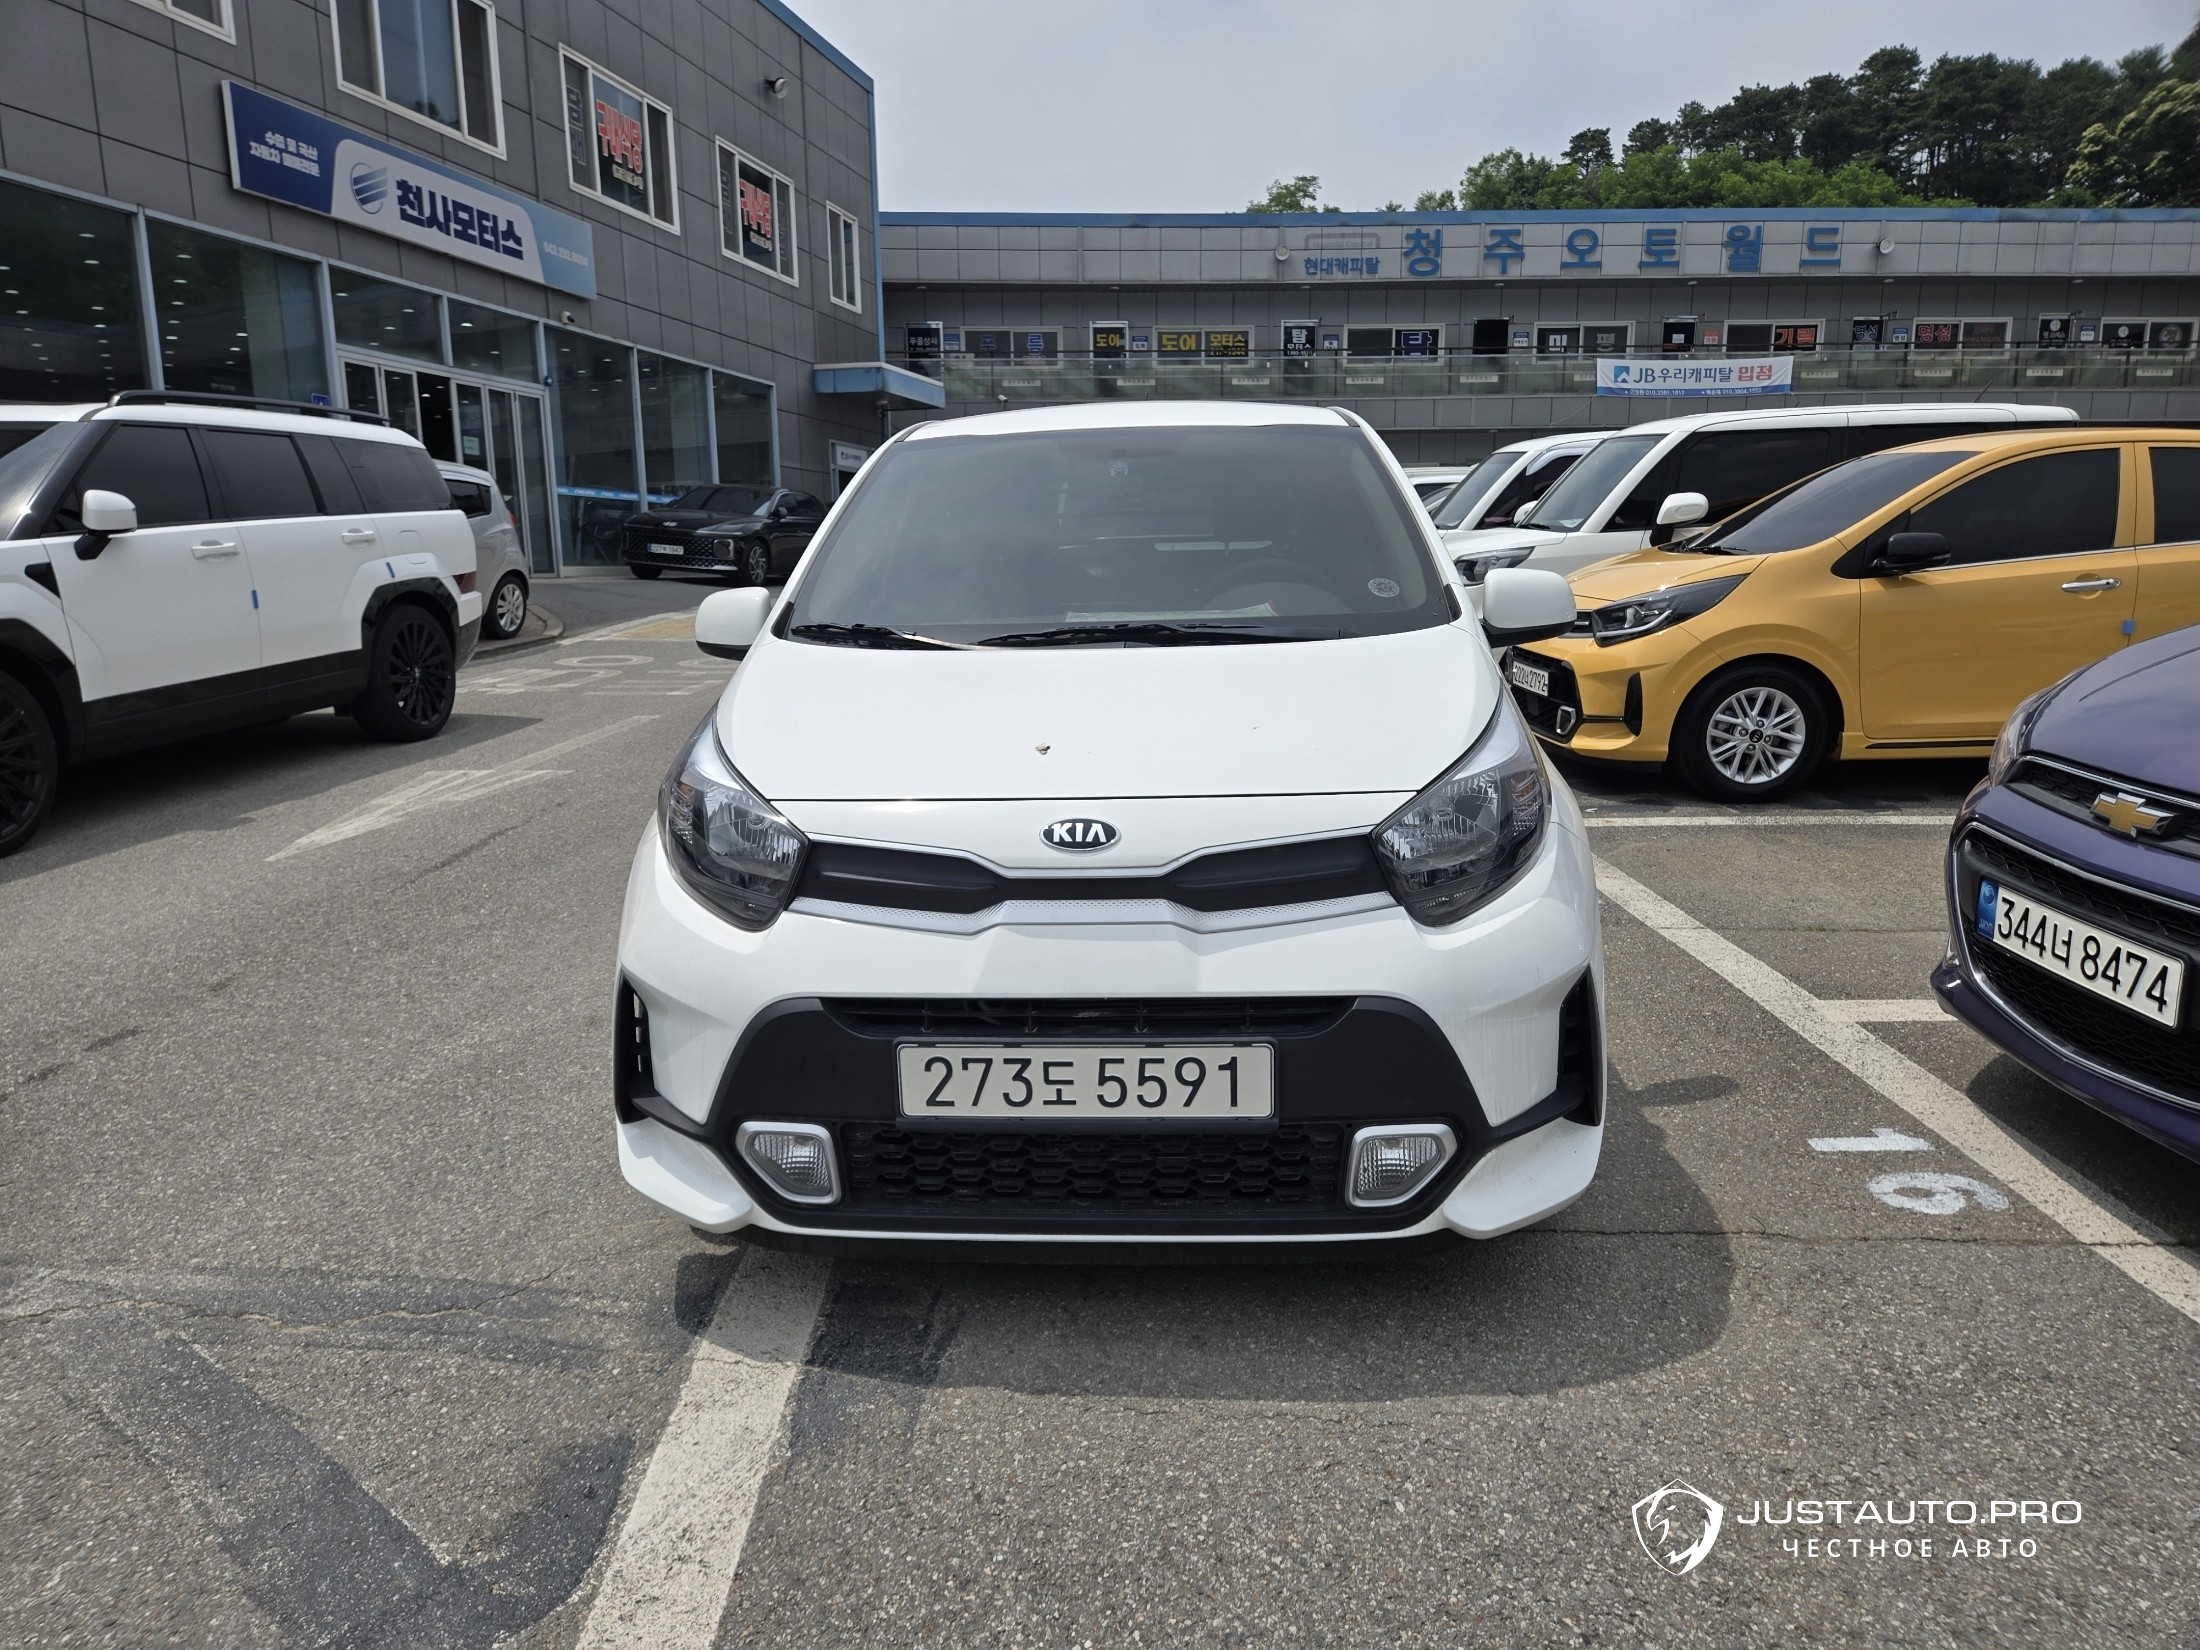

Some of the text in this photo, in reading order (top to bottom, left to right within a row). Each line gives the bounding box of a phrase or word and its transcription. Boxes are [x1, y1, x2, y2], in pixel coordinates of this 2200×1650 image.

[249, 140, 281, 164] 자동차
[396, 178, 524, 261] 천사모터스
[1303, 256, 1380, 276] 현대캐피탈
[1096, 334, 1120, 347] 도어
[1161, 333, 1245, 351] 도어 모터스
[1291, 328, 1308, 344] 탑
[1855, 324, 1879, 340] 명성
[1917, 324, 1952, 344] 명성
[1737, 364, 1773, 382] 입점
[1051, 822, 1107, 843] KIA
[1998, 896, 2169, 1012] 344너 8474
[923, 1055, 1238, 1108] 273도 5591
